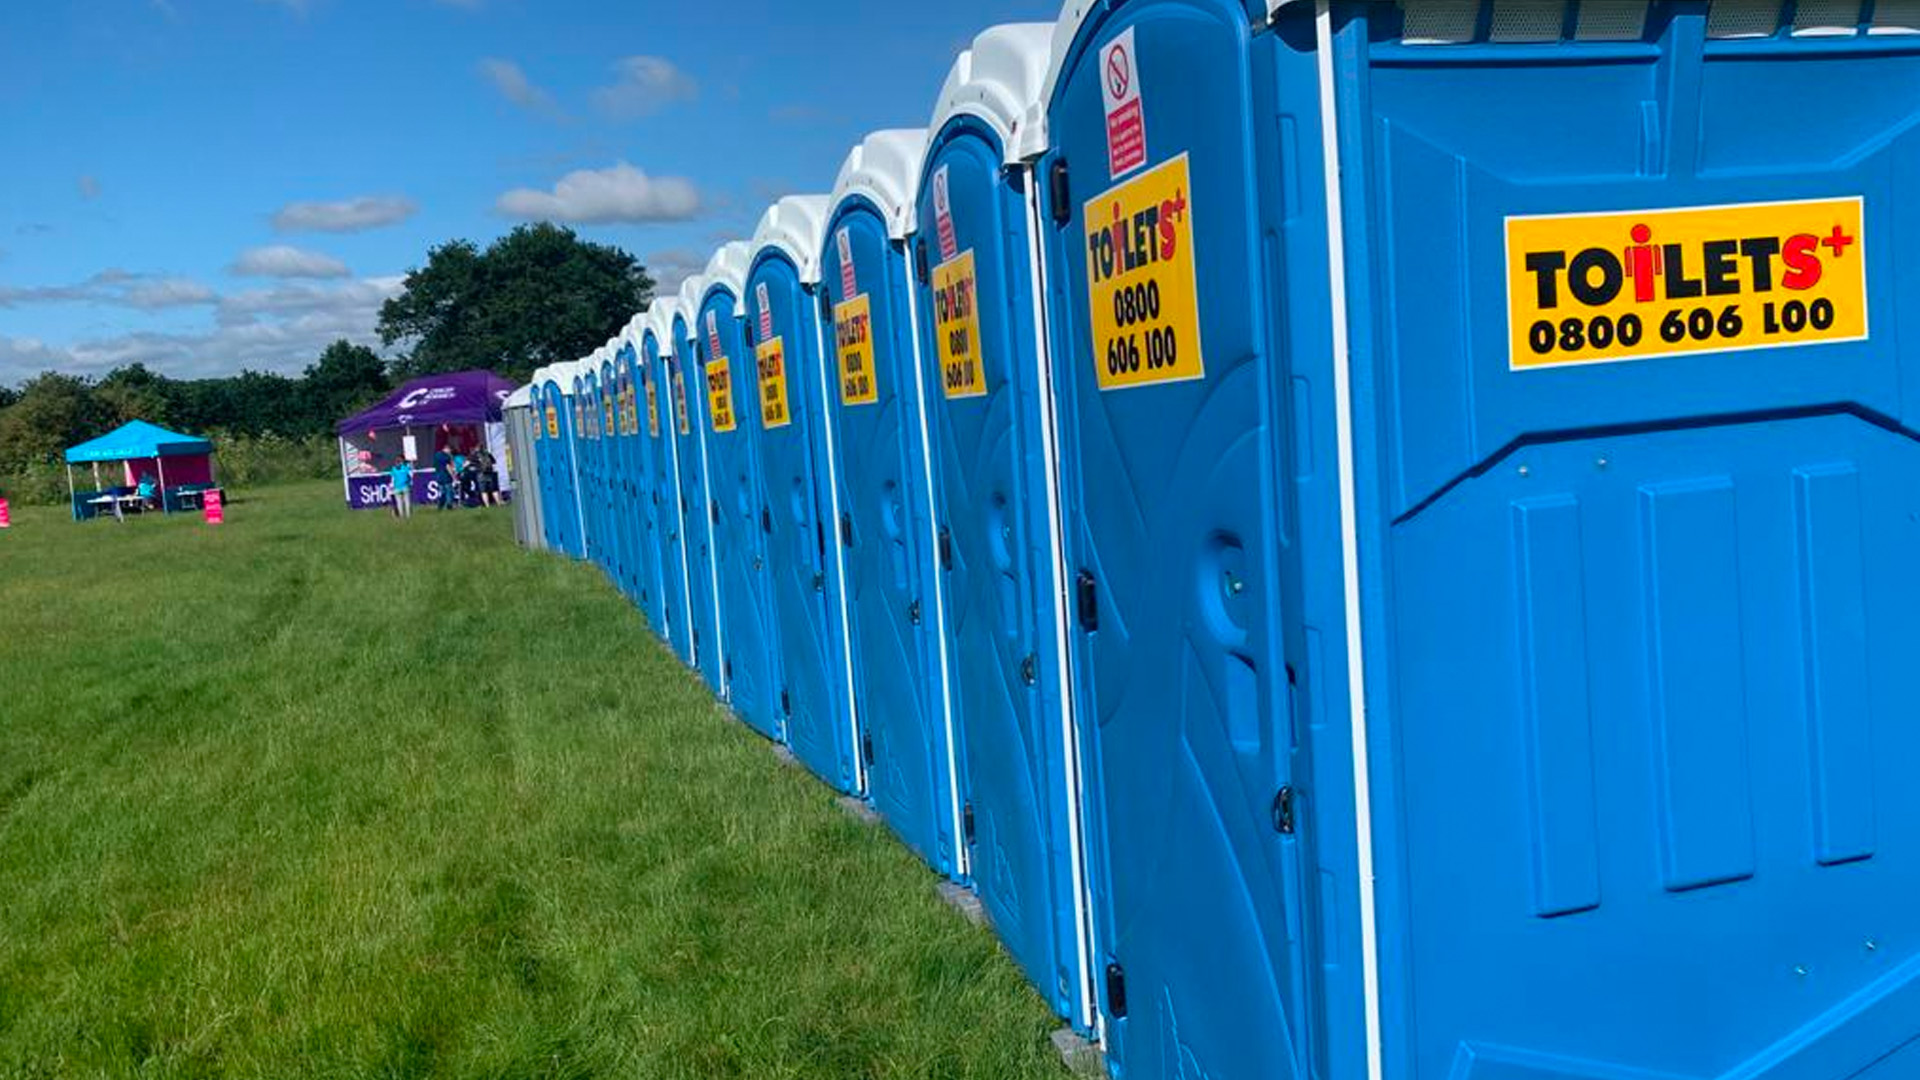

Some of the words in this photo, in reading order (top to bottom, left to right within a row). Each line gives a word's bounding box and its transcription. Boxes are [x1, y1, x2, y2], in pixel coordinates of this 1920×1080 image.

[1114, 278, 1159, 328] 0800
[1107, 333, 1140, 376] 606
[1528, 313, 1643, 355] 0800
[1659, 304, 1743, 343] 606
